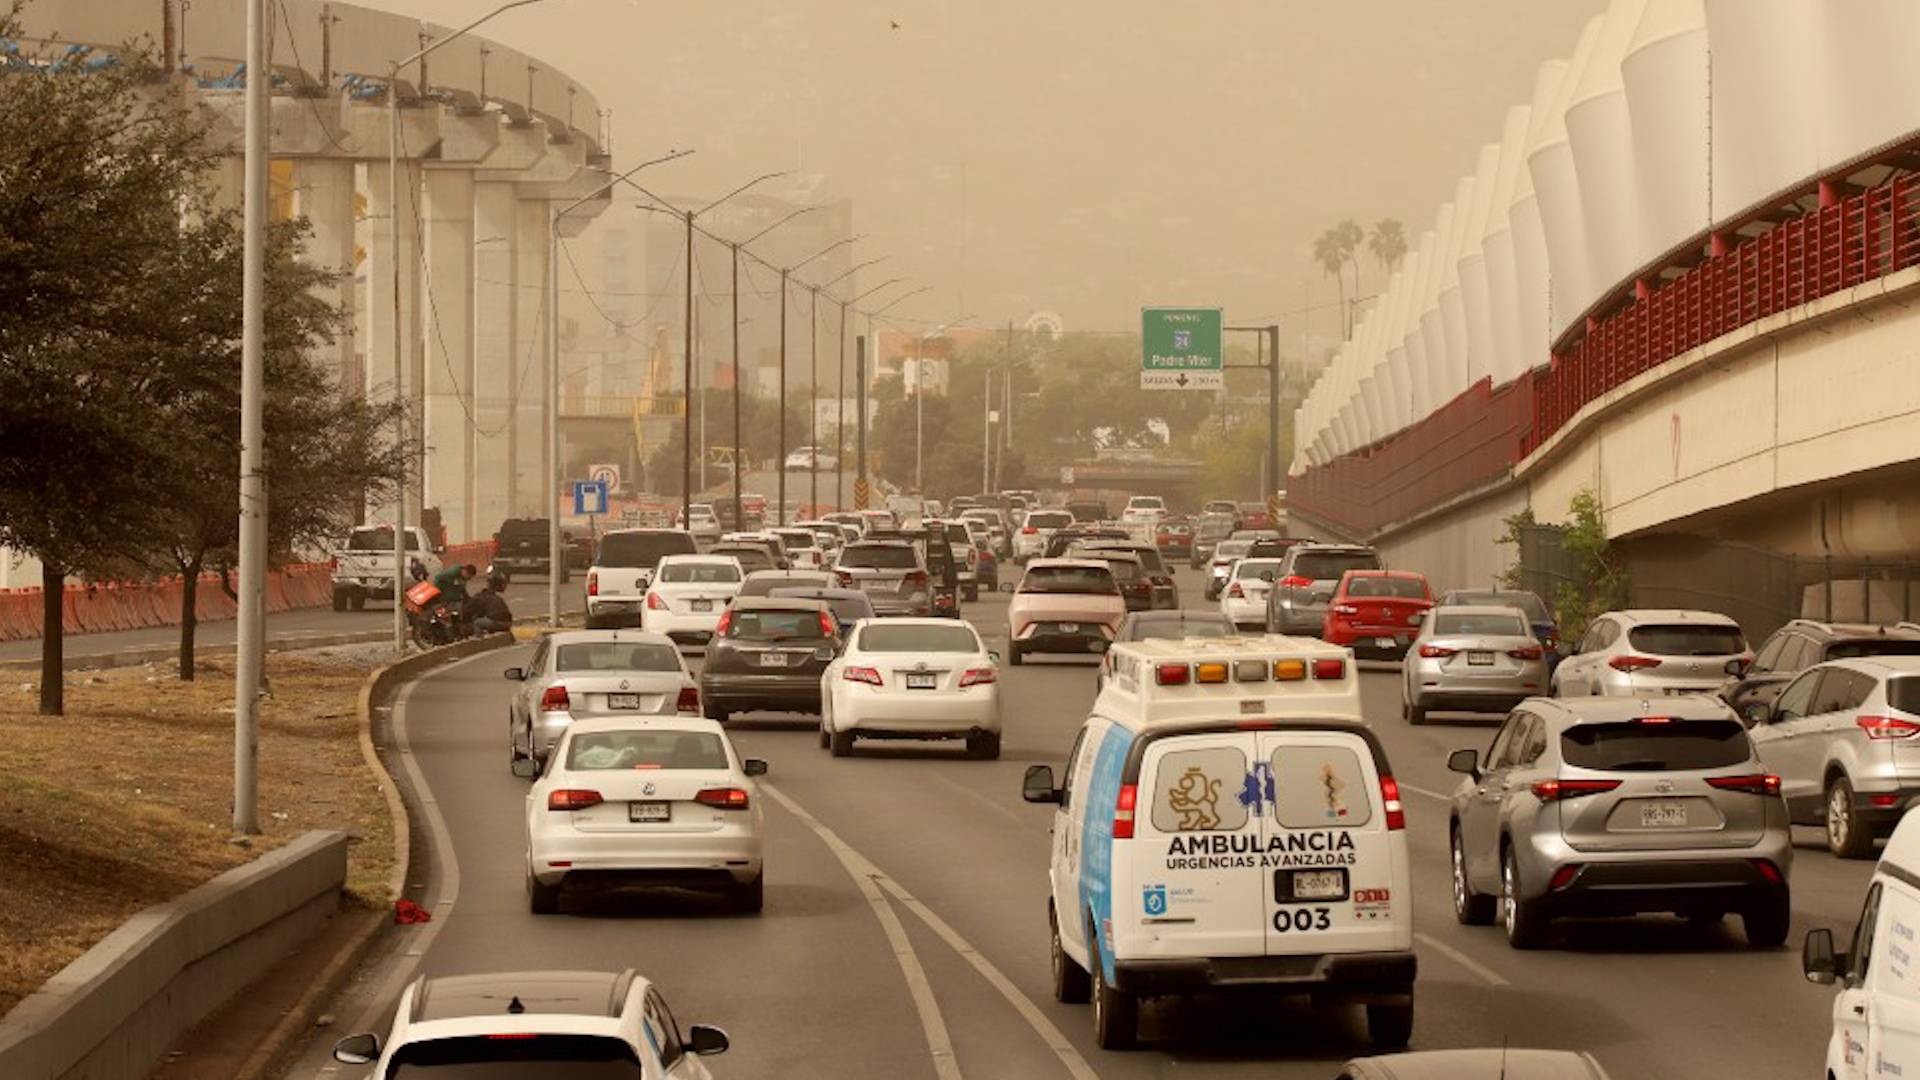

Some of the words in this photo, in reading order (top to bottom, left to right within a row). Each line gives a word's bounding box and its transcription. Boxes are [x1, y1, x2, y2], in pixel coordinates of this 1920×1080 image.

[1152, 354, 1185, 366] Padre
[1188, 354, 1212, 366] Mier
[1168, 831, 1355, 856] AMBULANCIA
[1166, 856, 1255, 869] URGENCIAS
[1260, 853, 1356, 867] AVANZADAS
[1355, 889, 1388, 902] 911
[1273, 908, 1330, 932] 003
